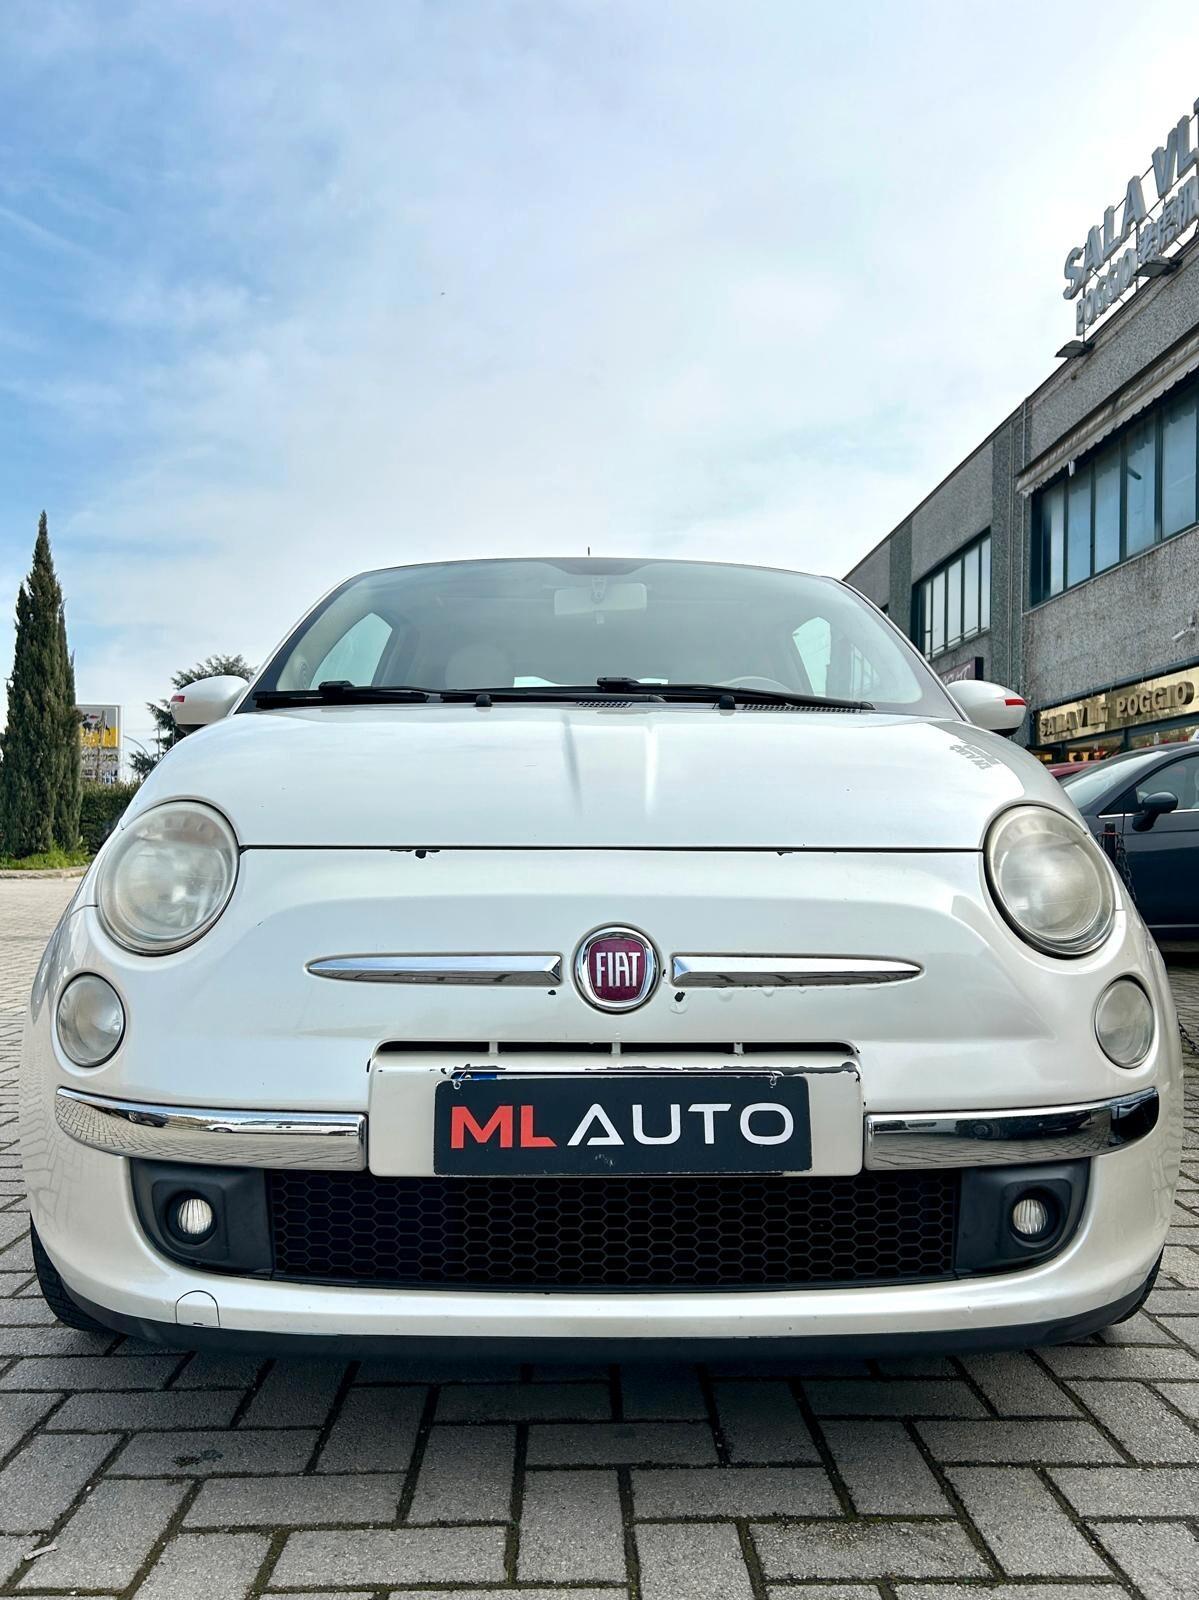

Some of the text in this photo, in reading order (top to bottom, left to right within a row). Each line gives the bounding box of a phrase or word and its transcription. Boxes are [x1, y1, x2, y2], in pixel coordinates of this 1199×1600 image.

[1063, 97, 1199, 300] SALA VL
[1076, 248, 1138, 336] POGGIO
[1039, 711, 1079, 737] SALA
[1117, 681, 1194, 718] POGGIO
[596, 952, 640, 987] FIAT
[451, 1102, 795, 1149] ML AUTO
